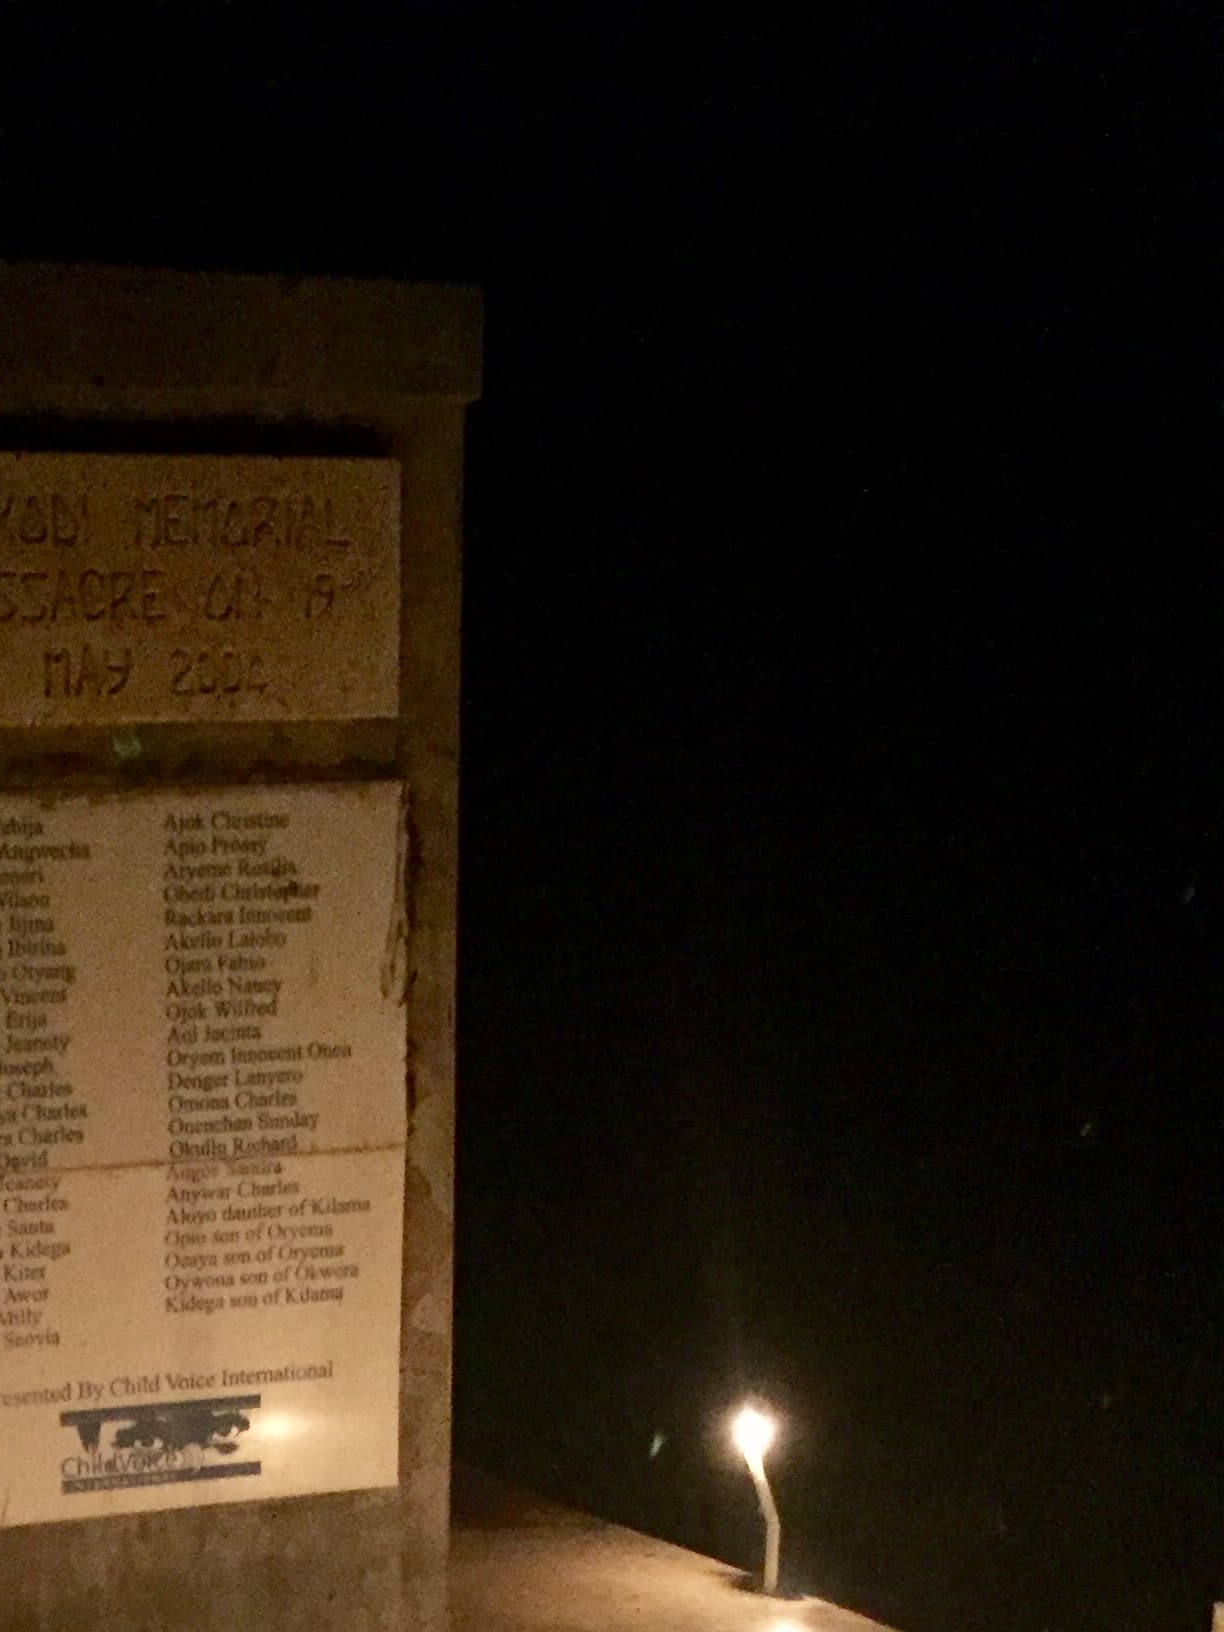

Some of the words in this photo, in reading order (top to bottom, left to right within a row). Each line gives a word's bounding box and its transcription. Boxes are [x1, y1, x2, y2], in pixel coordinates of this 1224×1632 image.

[204, 570, 264, 622] ON
[43, 644, 134, 700] MAY
[6, 1081, 74, 1099] Charles
[234, 1089, 299, 1109] Charles
[21, 1103, 88, 1121] Charles
[18, 1126, 85, 1145] Charles
[237, 1180, 300, 1199] Charles
[3, 1195, 70, 1214] Charles
[288, 1200, 308, 1217] of
[212, 1229, 240, 1244] son
[245, 1222, 264, 1240] of
[223, 1250, 251, 1266] son
[255, 1246, 276, 1262] of
[239, 1271, 268, 1286] son
[272, 1265, 292, 1283] of
[229, 1295, 258, 1309] son
[261, 1289, 281, 1307] of
[78, 1380, 105, 1402] By
[109, 1373, 162, 1397] Child
[166, 1372, 216, 1392] Voice
[221, 1360, 335, 1387] International
